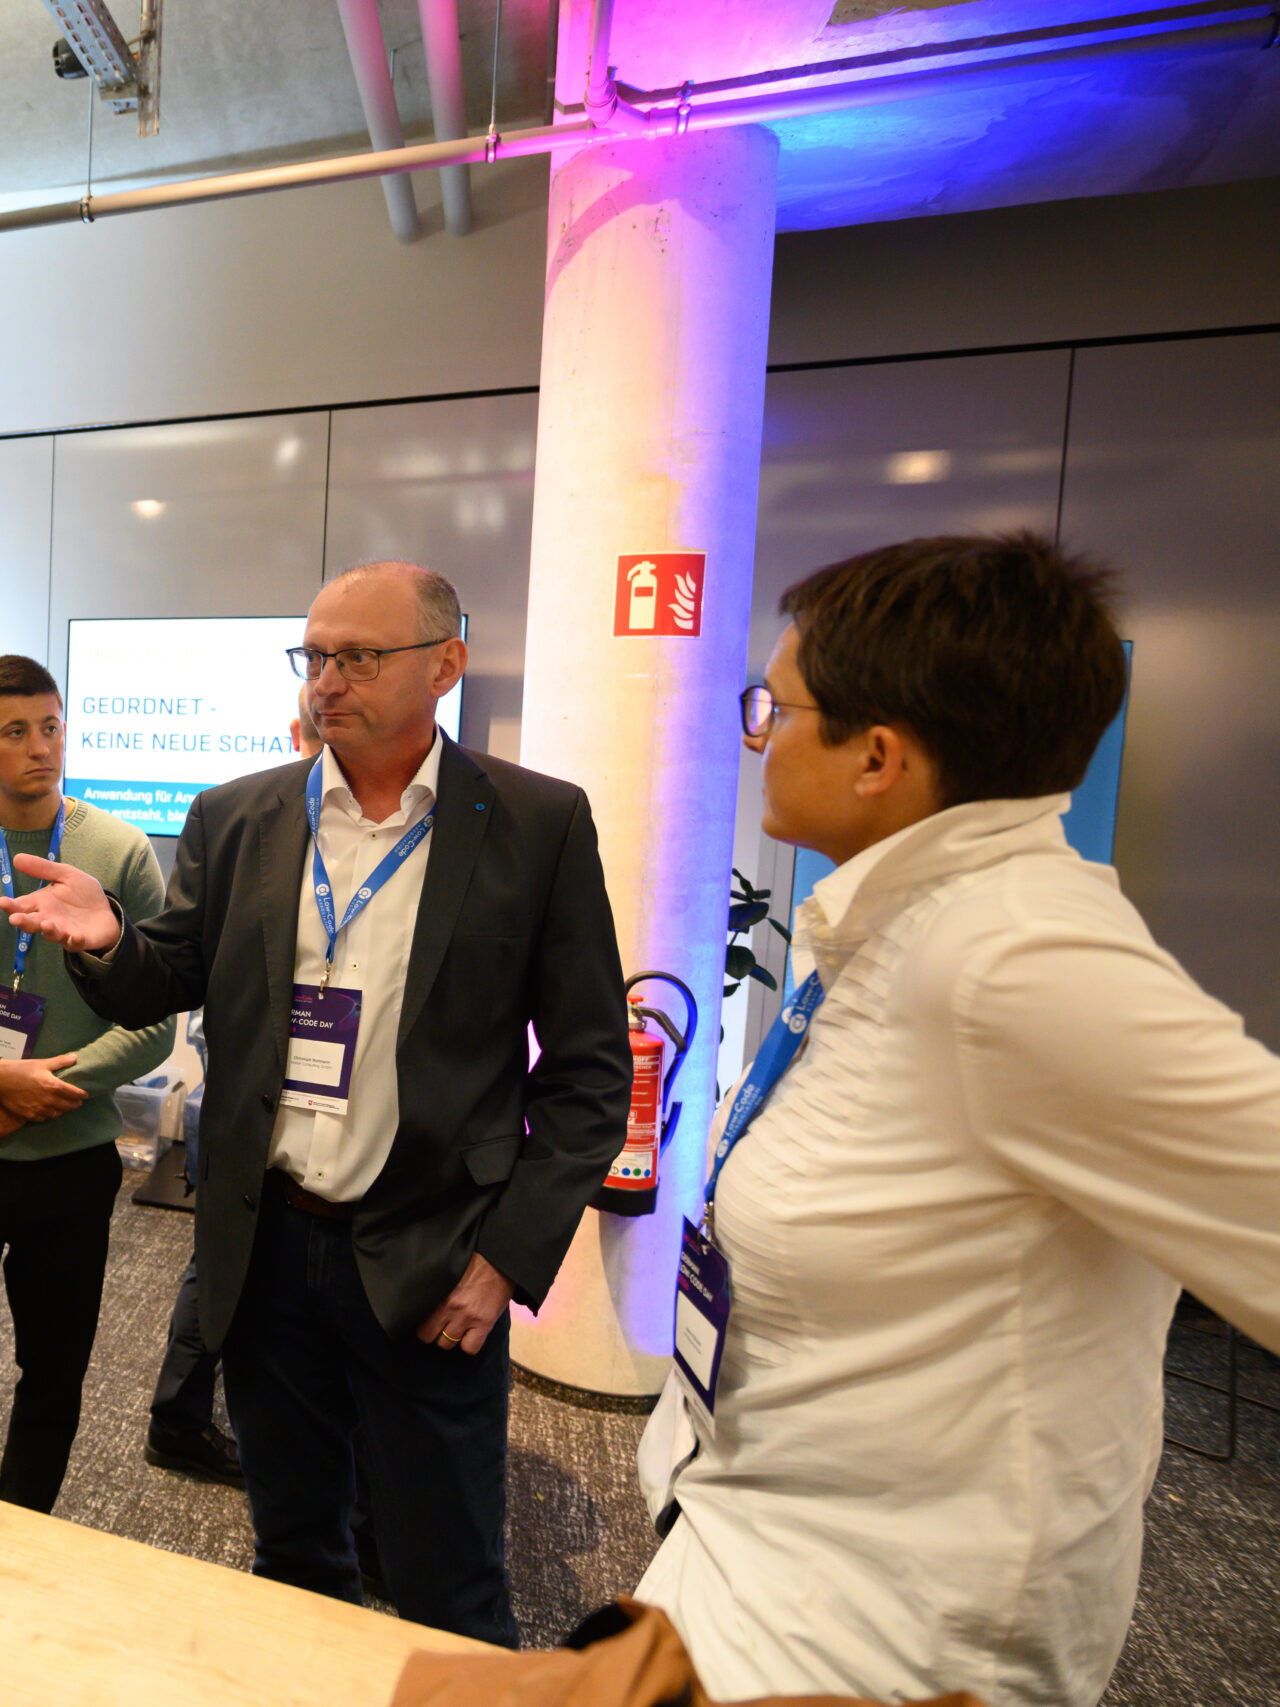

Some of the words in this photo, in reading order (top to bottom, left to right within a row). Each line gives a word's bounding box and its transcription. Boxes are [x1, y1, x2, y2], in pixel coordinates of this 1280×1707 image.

[82, 697, 203, 715] GEORDNET
[81, 732, 144, 750] KEINE
[152, 733, 211, 751] NEUE
[83, 787, 152, 804] Anwendung
[155, 790, 172, 803] für
[398, 827, 426, 857] Low-Code
[323, 896, 334, 934] Low-Code
[319, 1020, 334, 1029] DAY
[724, 1084, 755, 1137] Low-Code
